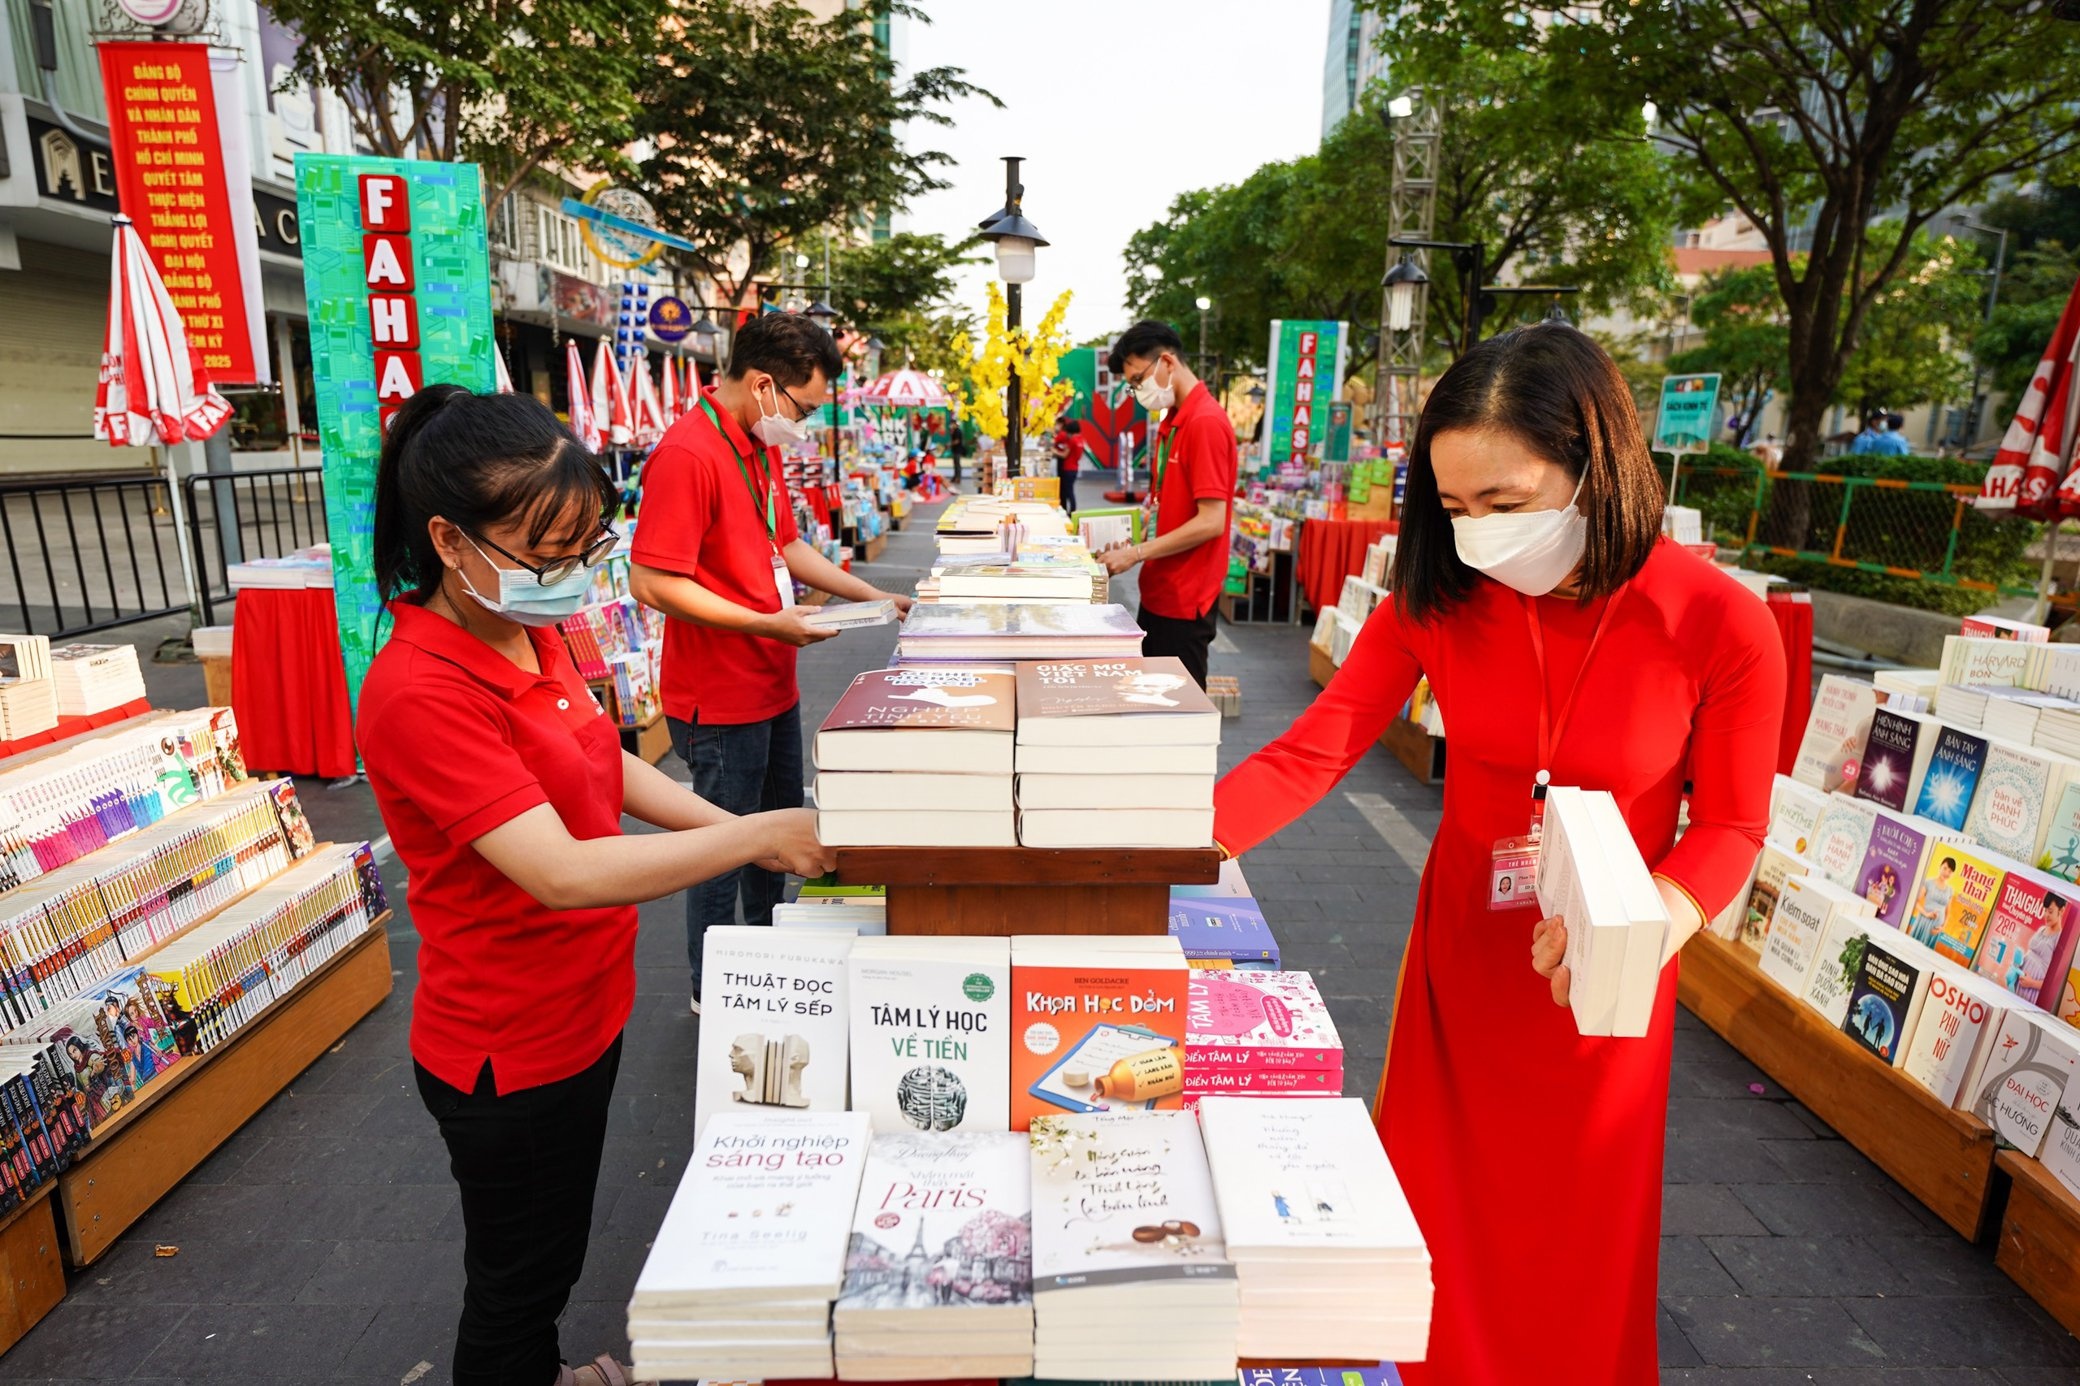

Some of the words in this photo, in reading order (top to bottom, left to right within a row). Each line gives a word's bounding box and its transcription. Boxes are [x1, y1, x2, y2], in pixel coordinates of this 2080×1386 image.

[136, 128, 173, 143] THÀNH
[175, 127, 197, 144] PHỐ
[174, 152, 205, 165] MINH
[179, 170, 204, 186] TÂM
[173, 295, 197, 308] ÀNH
[197, 292, 222, 308] PHỐ
[366, 178, 416, 432] FAHA
[203, 355, 231, 368] 2025
[1973, 655, 2026, 669] HARVARD
[1095, 670, 1144, 678] NAM
[1961, 741, 1978, 755] TAY
[1960, 863, 1996, 892] Mang
[1963, 880, 1989, 903] thai
[716, 950, 775, 959] HIROMORI
[723, 972, 787, 991] THUẬT
[793, 978, 833, 995] ĐỌC
[722, 993, 760, 1010] TÂM
[767, 997, 788, 1012] LÝ
[794, 999, 832, 1016] SẾP
[1084, 995, 1124, 1014] HỌC
[1930, 977, 1985, 1025] OSHO
[870, 1002, 911, 1027] TÂM
[917, 1005, 940, 1028] LÝ
[946, 1010, 987, 1035] HỌC
[1189, 1000, 1213, 1030] TÂM
[891, 1032, 918, 1057] VỀ
[923, 1034, 967, 1061] TIỀN
[1207, 1051, 1233, 1063] TÂM
[1236, 1050, 1250, 1064] LÝ
[1211, 1074, 1235, 1086] TÂM
[1238, 1074, 1252, 1087] LÝ
[2006, 1078, 2025, 1099] ĐẠI
[2025, 1089, 2050, 1114] HỌC
[2000, 1104, 2039, 1136] HƯỚNG
[714, 1134, 766, 1149] Khởi
[772, 1135, 850, 1151] nghiệp
[706, 1149, 785, 1171] sáng
[796, 1150, 844, 1170] tạo
[880, 1182, 987, 1210] Paris
[702, 1230, 740, 1241] Tina
[750, 1230, 808, 1242] Seelig
